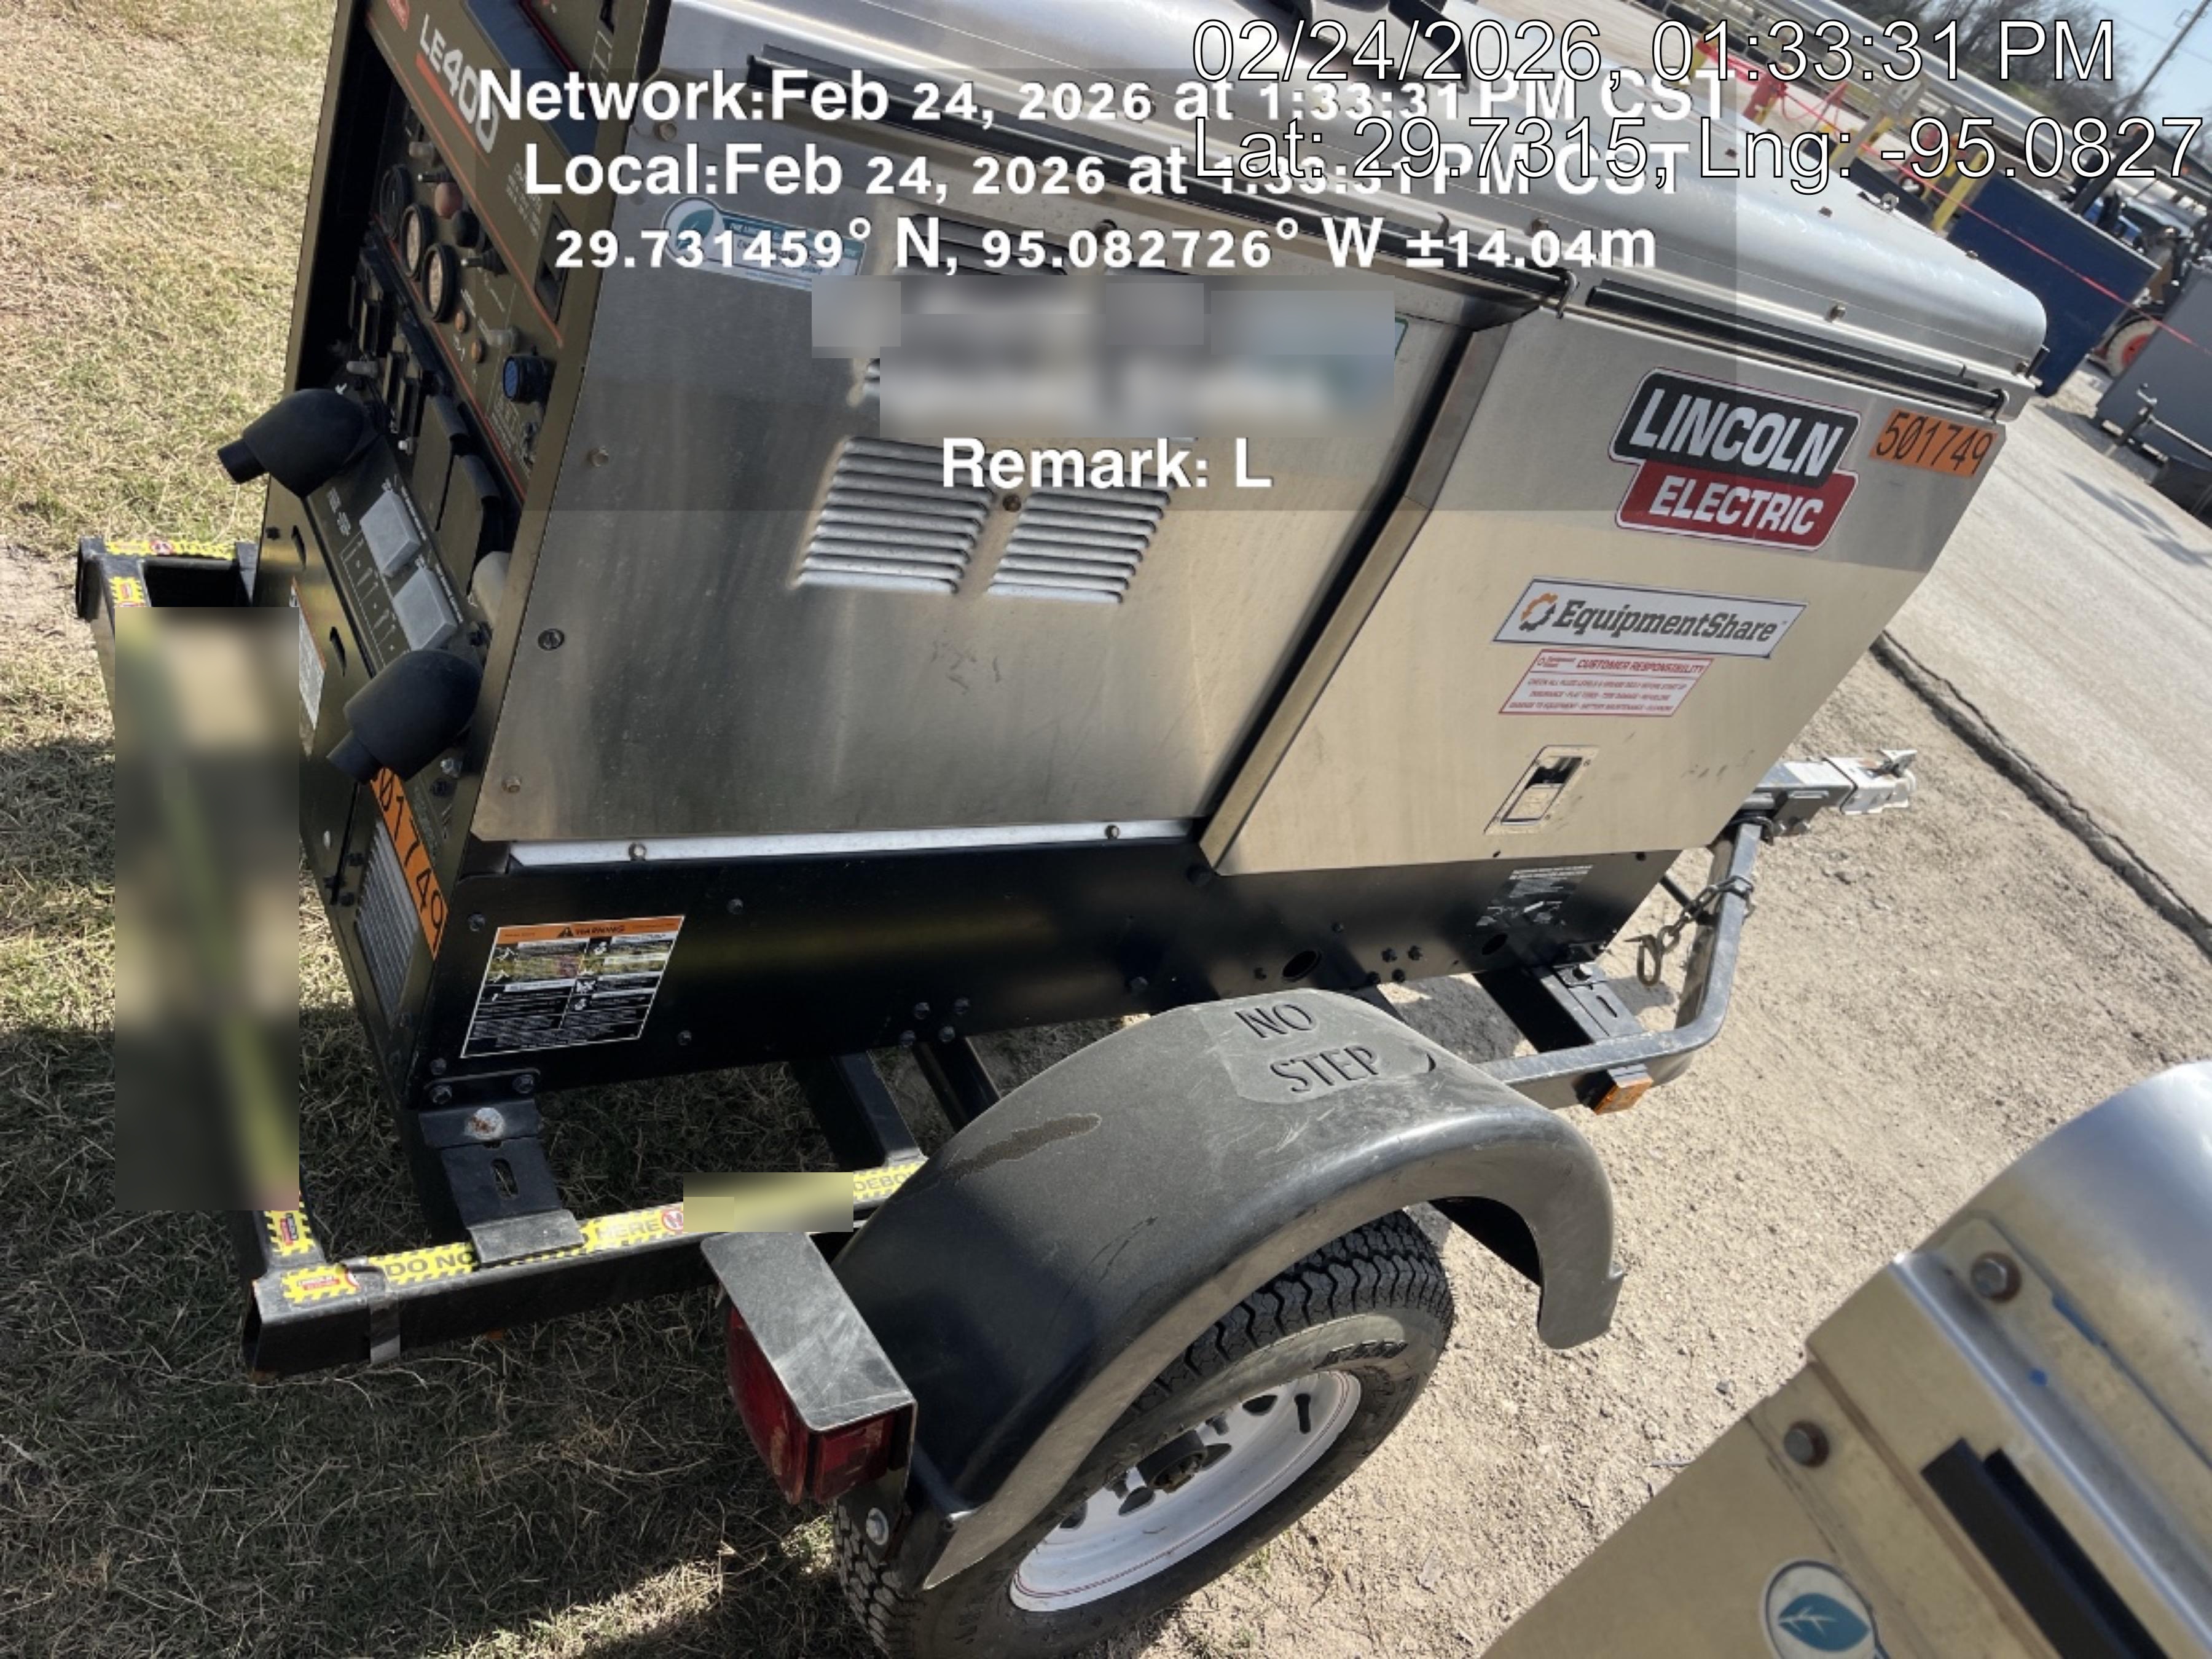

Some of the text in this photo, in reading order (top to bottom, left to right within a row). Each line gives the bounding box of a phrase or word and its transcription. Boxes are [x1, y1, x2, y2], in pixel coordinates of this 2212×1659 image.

[1628, 388, 1843, 477] LINCOLN
[1649, 474, 1824, 535] ELECTRIC
[1552, 600, 1778, 642] EquipmentShare
[379, 768, 443, 952] 01749
[1234, 1003, 1316, 1038] NO
[1269, 1045, 1379, 1093] STEP
[385, 1258, 428, 1277] DO
